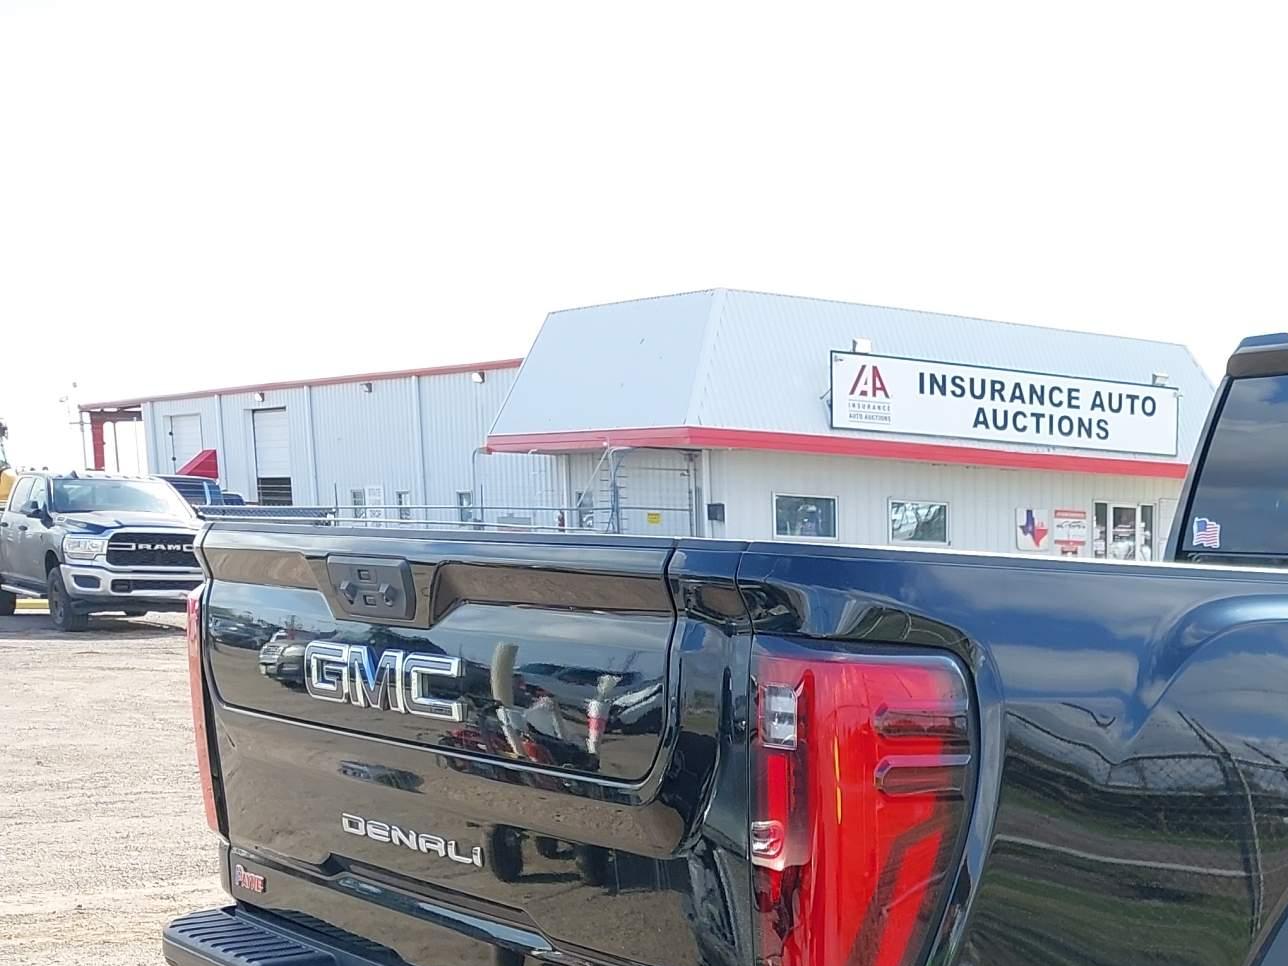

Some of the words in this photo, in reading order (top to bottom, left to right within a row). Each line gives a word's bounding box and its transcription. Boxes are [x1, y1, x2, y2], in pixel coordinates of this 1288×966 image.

[848, 402, 891, 411] INSURANCE
[918, 371, 1081, 410] INSURANCE
[1090, 391, 1156, 417] AUTO
[865, 414, 891, 423] AUCTIONS
[972, 407, 1110, 440] AUCTIONS
[305, 640, 465, 723] GMC
[340, 812, 485, 868] DENALI
